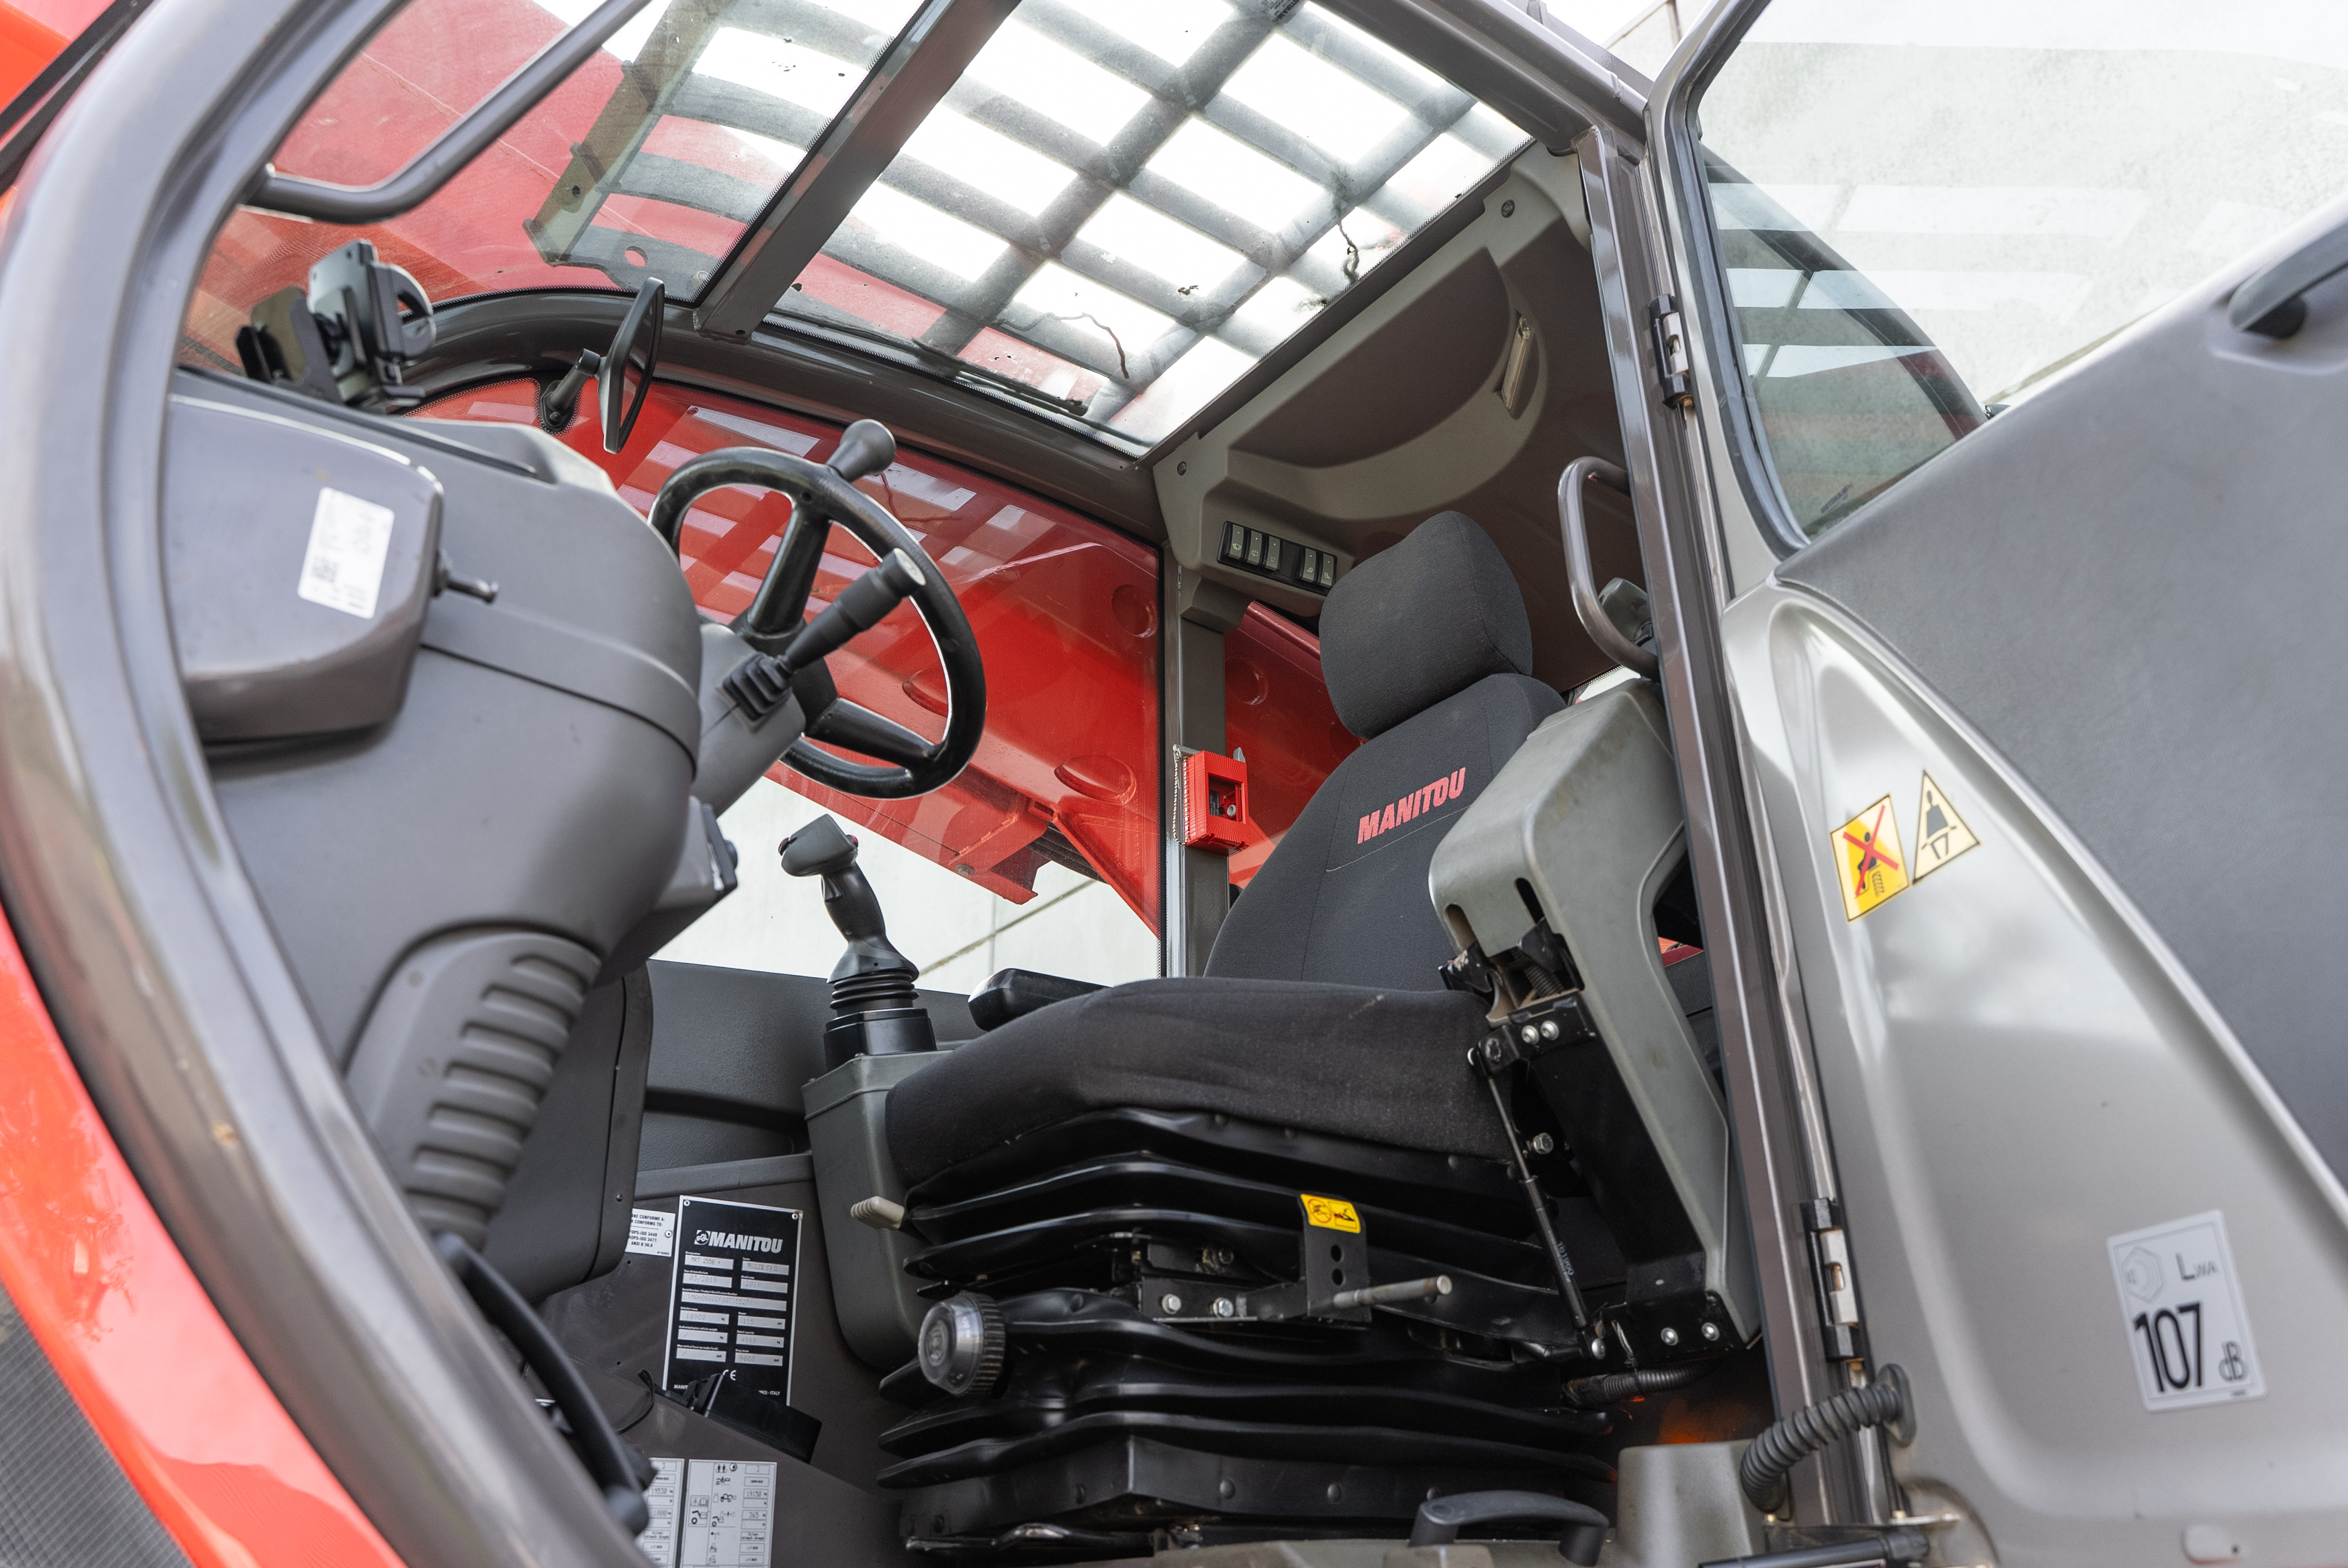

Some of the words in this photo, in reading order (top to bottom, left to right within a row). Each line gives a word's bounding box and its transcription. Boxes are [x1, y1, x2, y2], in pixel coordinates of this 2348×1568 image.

[1357, 767, 1466, 844] MANITOU
[709, 1231, 783, 1254] MANITOU
[689, 1275, 717, 1283] 03/2019
[2134, 1301, 2205, 1392] 107
